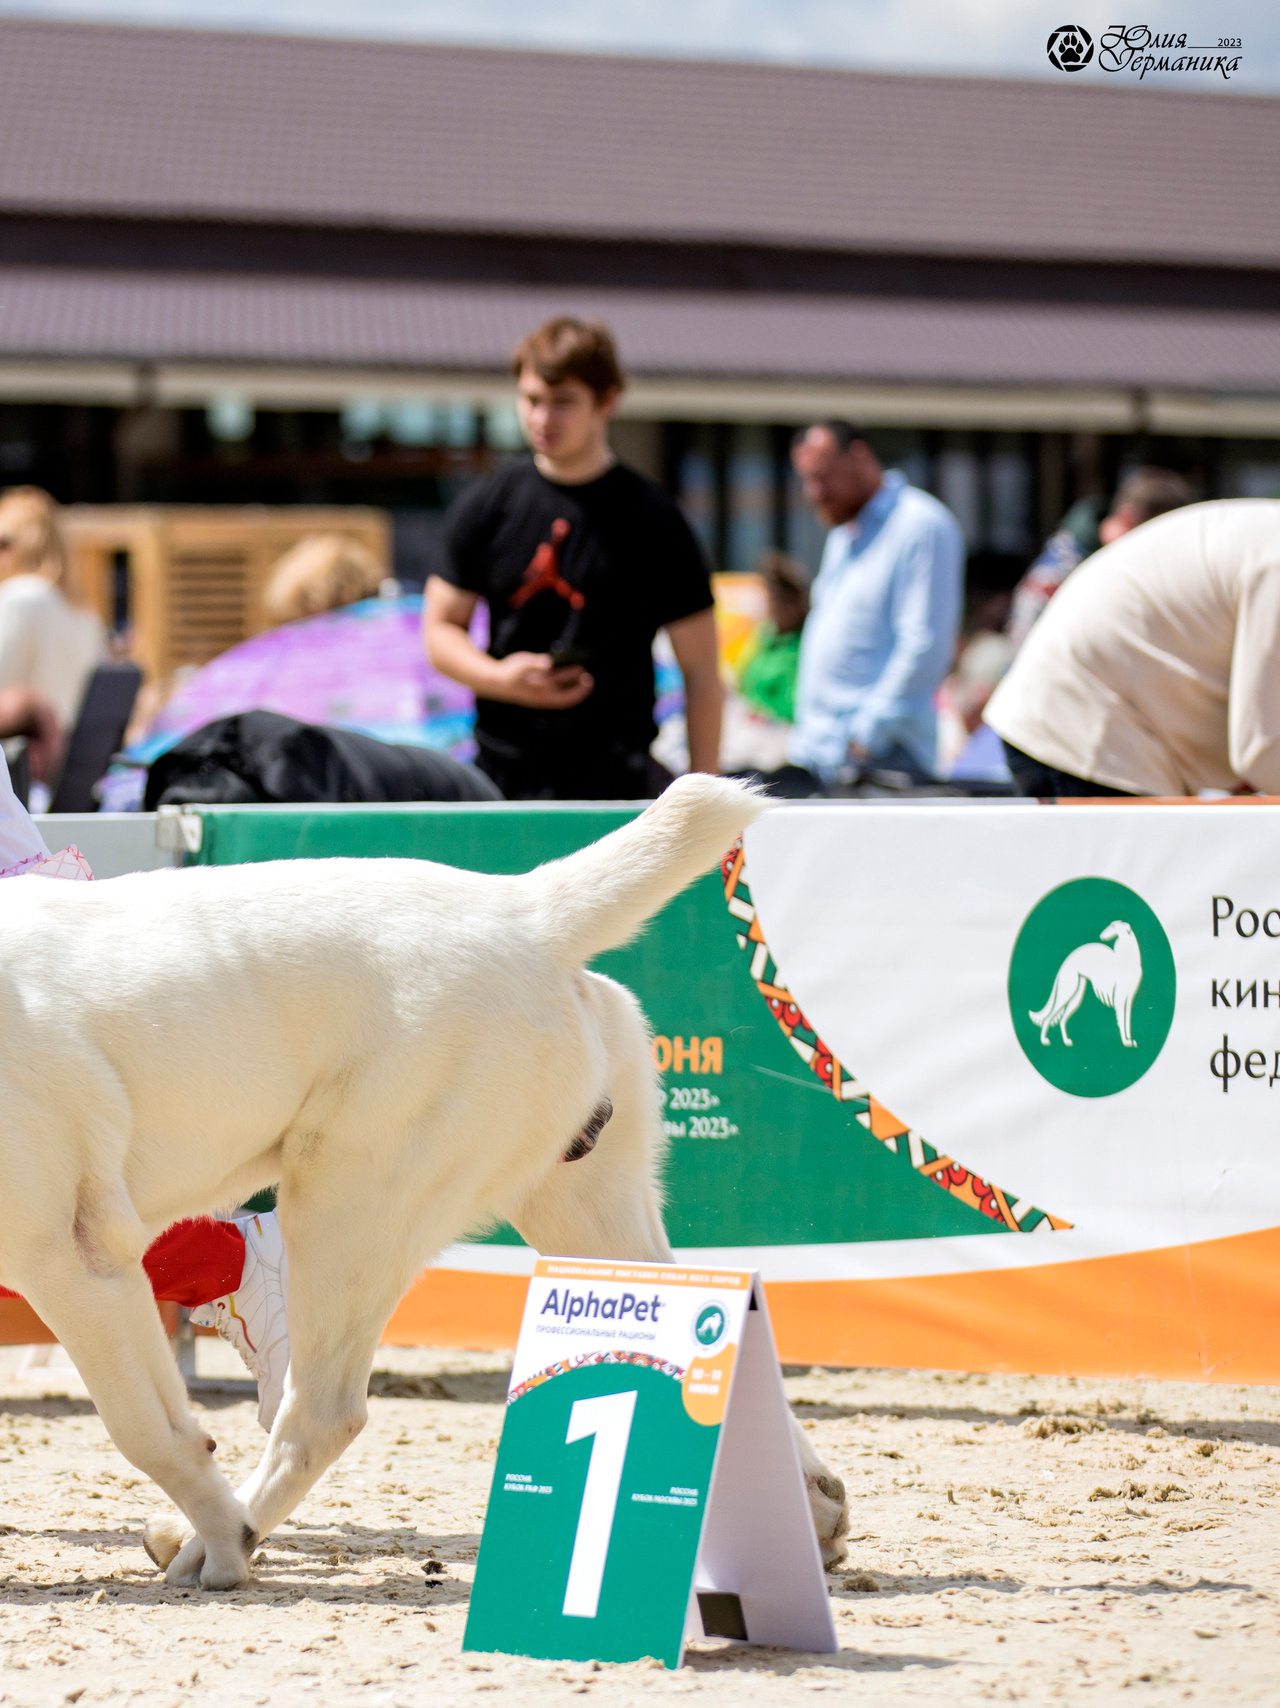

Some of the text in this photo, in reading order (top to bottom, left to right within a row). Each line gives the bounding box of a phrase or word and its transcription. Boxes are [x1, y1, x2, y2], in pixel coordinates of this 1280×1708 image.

[1212, 894, 1280, 938] Рос
[1211, 977, 1280, 1008] кин
[540, 1288, 661, 1323] AlphaPet
[535, 1324, 617, 1338] ПРОФЕССИОНАЛЬНЫЕ
[562, 1390, 638, 1618] 1
